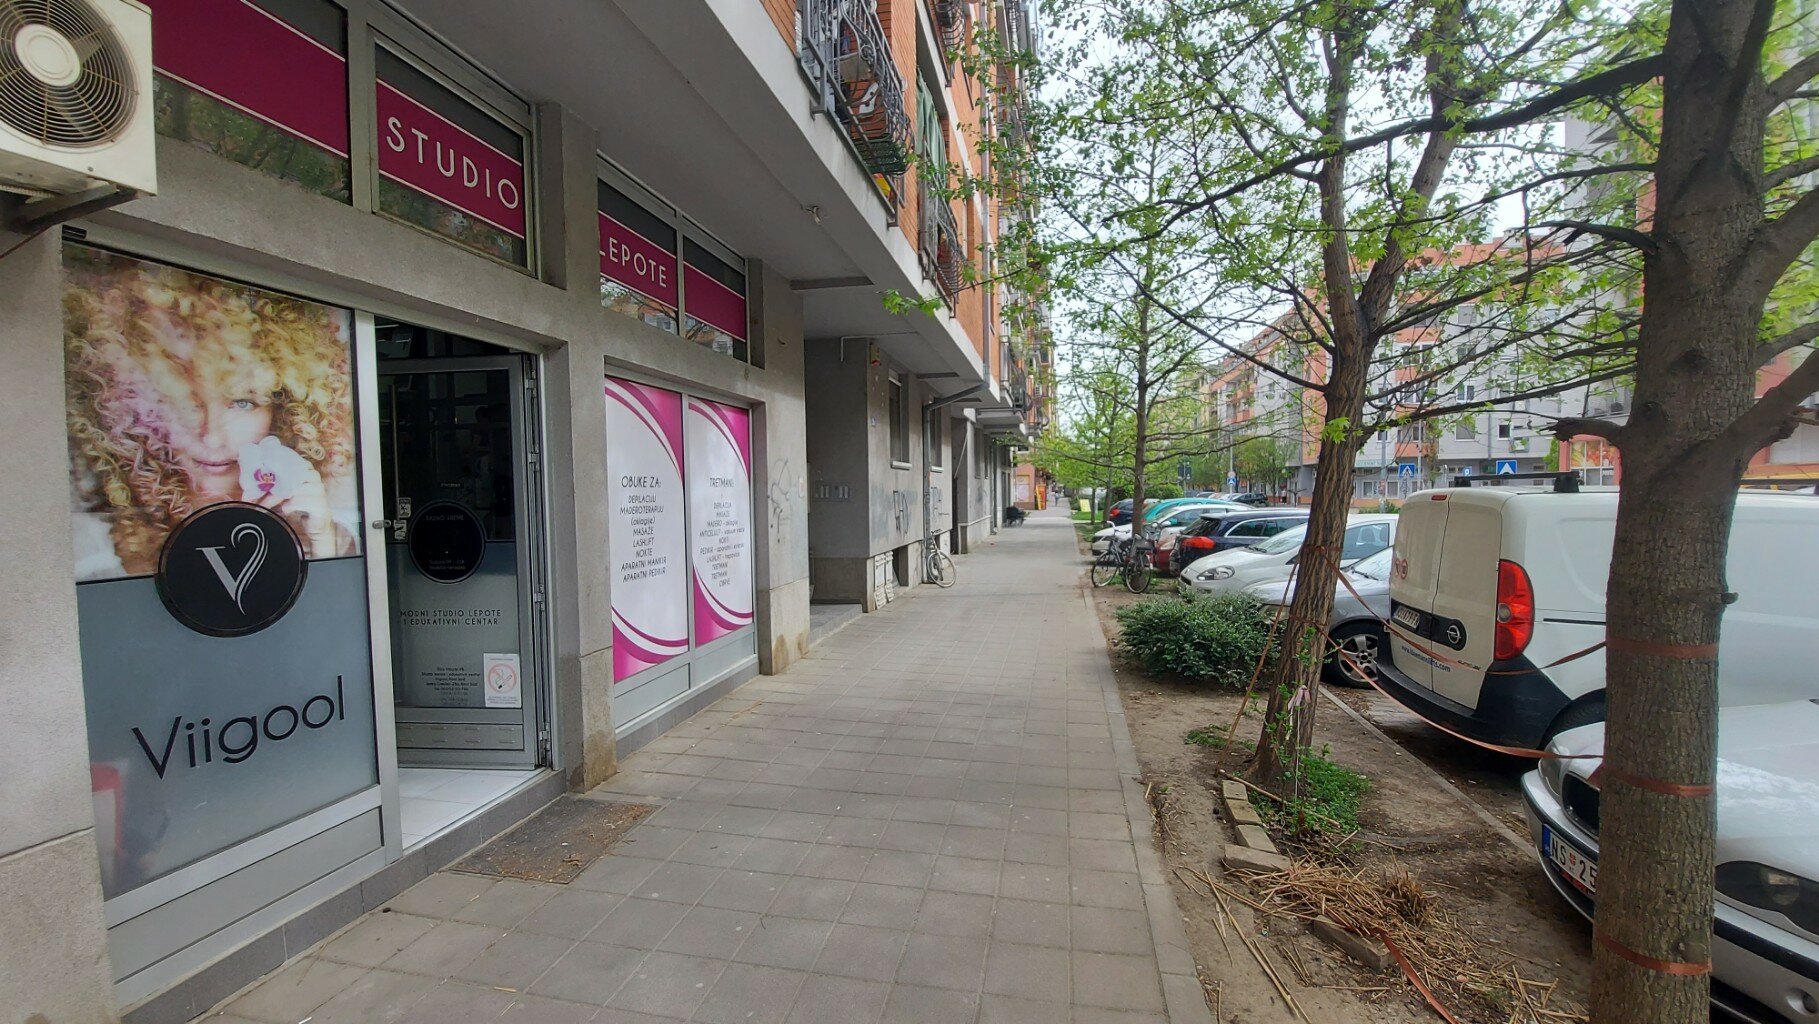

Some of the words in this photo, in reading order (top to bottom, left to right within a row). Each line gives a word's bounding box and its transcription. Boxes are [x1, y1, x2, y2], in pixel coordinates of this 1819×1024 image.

[387, 116, 519, 209] STUDIO
[599, 236, 667, 288] EPOTE
[621, 475, 648, 488] OBUKE
[621, 560, 647, 572] APARATNI
[623, 570, 647, 583] APARATNI
[400, 609, 429, 618] MODNI
[433, 609, 465, 618] STUDIO
[468, 609, 501, 617] LEPOTE
[410, 618, 461, 626] EDUKATIVNI
[465, 618, 498, 626] CENTAR
[132, 675, 345, 780] Viigool
[1552, 837, 1567, 866] NS
